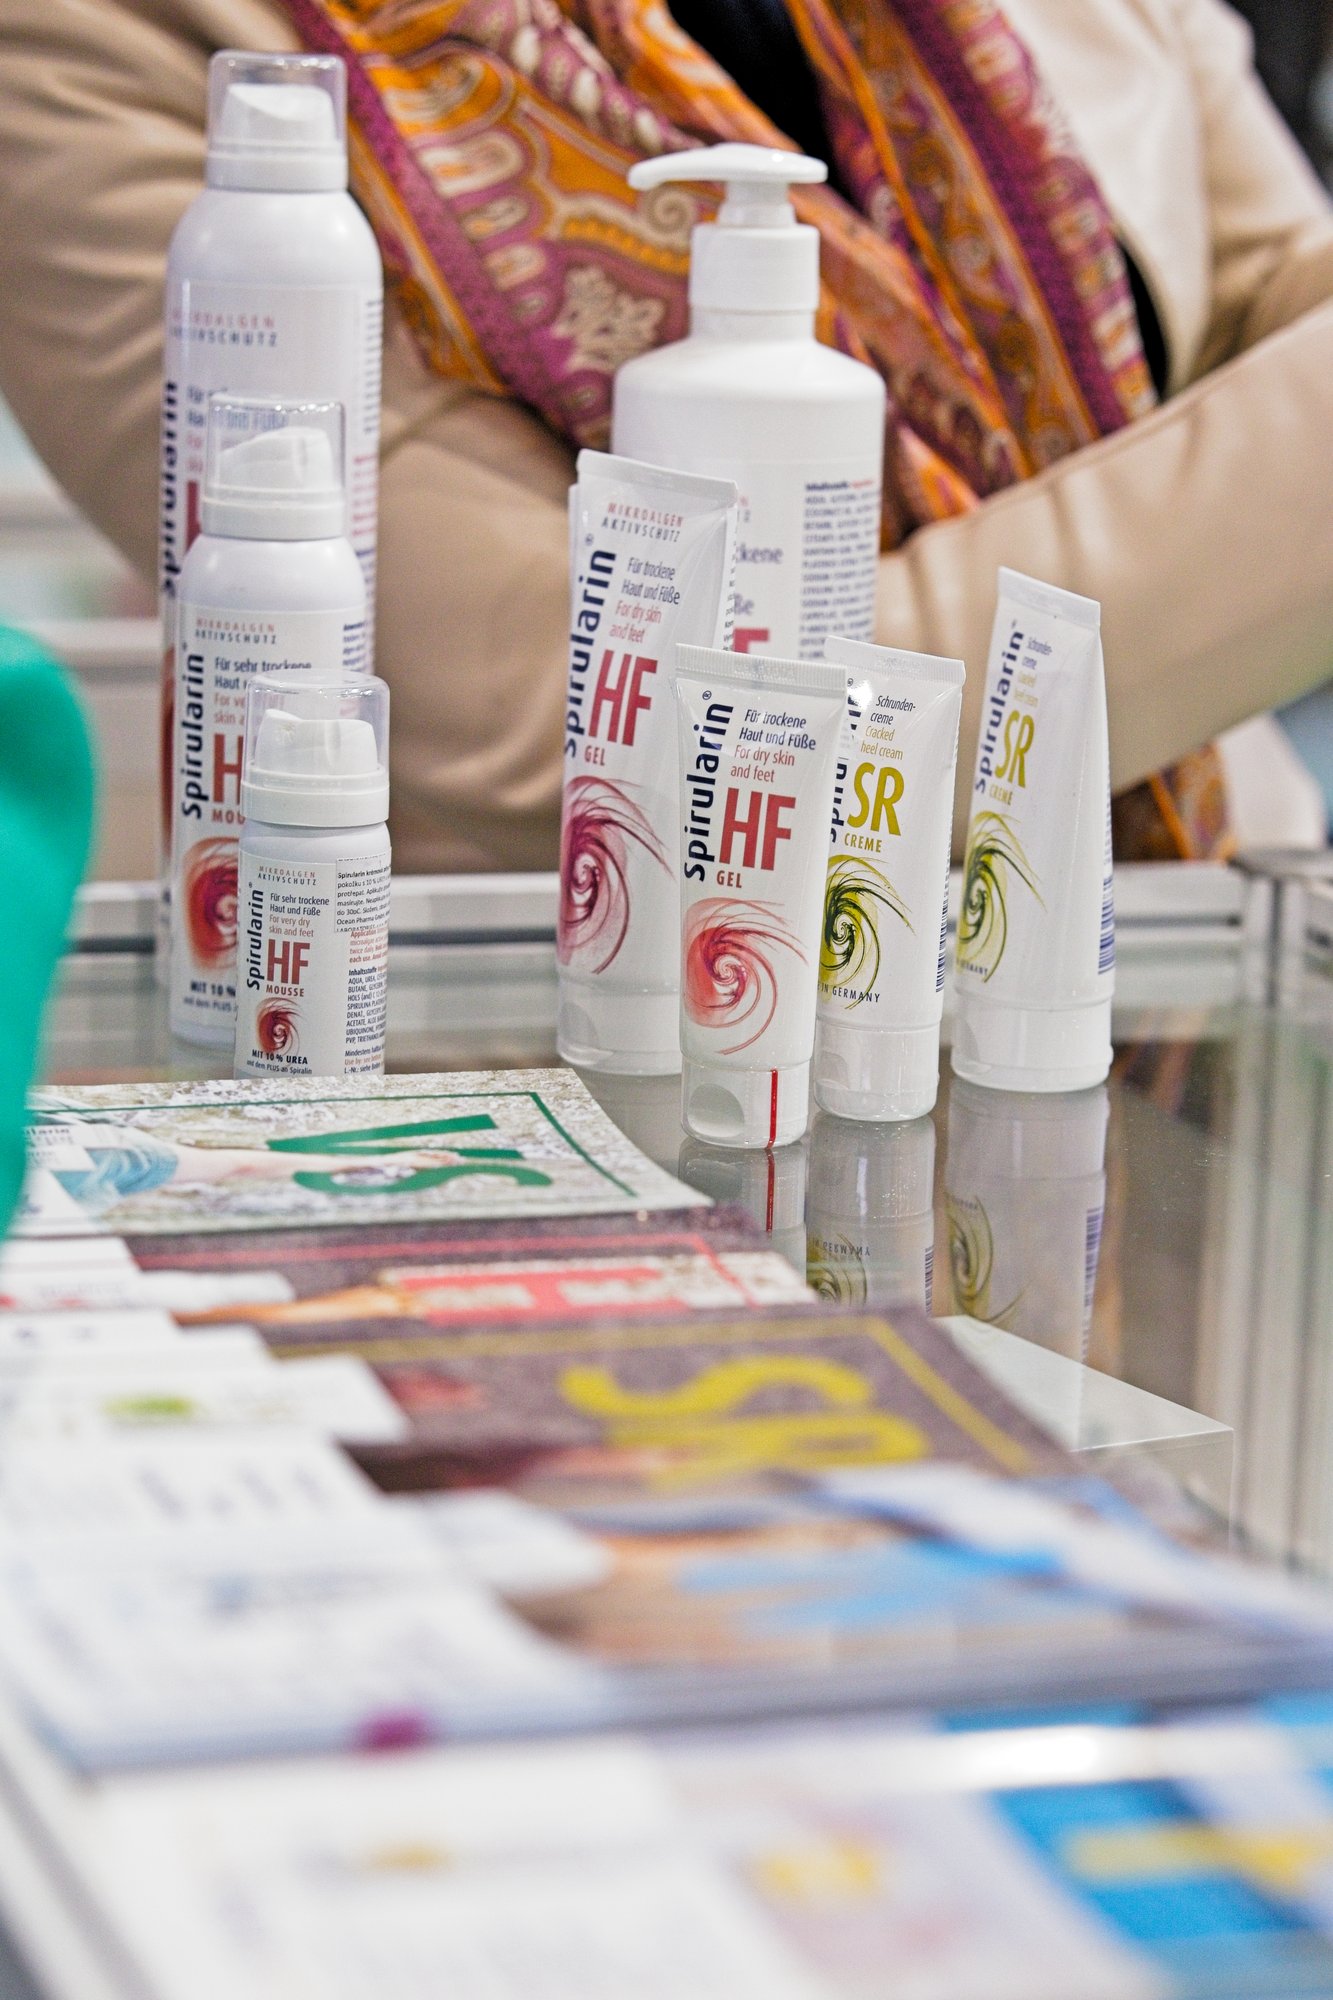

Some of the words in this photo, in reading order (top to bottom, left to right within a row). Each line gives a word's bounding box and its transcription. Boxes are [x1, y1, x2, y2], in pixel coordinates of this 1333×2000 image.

[608, 502, 684, 527] MIKROALGEN
[601, 517, 680, 542] AKTIVSCHUTZ
[627, 557, 643, 574] Für
[643, 561, 676, 581] trockene
[621, 579, 643, 598] Haut
[643, 583, 659, 600] und
[659, 585, 680, 605] Füße
[615, 600, 632, 616] For
[632, 602, 645, 623] dry
[195, 630, 277, 644] AKTIVSCHUTZ
[609, 623, 628, 640] and
[628, 623, 646, 643] feet
[215, 656, 230, 671] Für
[234, 657, 258, 672] sehr
[215, 676, 240, 689] Haut
[214, 692, 230, 706] For
[588, 649, 658, 747] HF
[876, 695, 916, 712] Schrunden-
[214, 710, 236, 724] skin
[744, 709, 760, 723] Für
[762, 710, 807, 729] trockene
[870, 712, 894, 726] creme
[738, 726, 763, 743] Haut
[765, 731, 785, 746] und
[787, 733, 817, 751] Füße
[865, 725, 895, 742] Cracked
[584, 745, 605, 766] GEL
[734, 745, 751, 760] For
[753, 747, 770, 767] dry
[773, 749, 795, 767] skin
[861, 741, 878, 755] heel
[879, 746, 904, 761] cream
[994, 710, 1035, 788] SR
[730, 764, 751, 780] and
[753, 766, 775, 783] feet
[846, 762, 904, 837] SR
[989, 783, 1013, 806] CREME
[719, 787, 797, 872] HF
[844, 832, 882, 853] CREME
[258, 873, 317, 886] AKTIVSCHUTZ
[259, 866, 316, 878] MIKROALGEN
[716, 870, 742, 889] GEL
[270, 893, 280, 901] Für
[281, 894, 297, 904] sehr
[298, 896, 330, 906] trockene
[269, 904, 285, 913] Haut
[287, 906, 301, 915] und
[303, 907, 321, 916] Füße
[269, 914, 279, 923] For
[281, 917, 297, 927] very
[298, 917, 310, 928] dry
[269, 925, 282, 934] skin
[284, 927, 297, 937] and
[299, 928, 314, 938] feet
[267, 938, 310, 985] HF
[191, 980, 207, 994] MIT
[211, 983, 224, 996] 10
[266, 984, 304, 997] MOUSSE
[821, 982, 829, 993] IN
[832, 985, 880, 1003] GERMANY
[252, 1049, 263, 1059] MIT
[266, 1052, 274, 1061] 10
[276, 1053, 283, 1062] %
[286, 1055, 308, 1065] UREA
[255, 1060, 265, 1070] dem
[266, 1063, 280, 1072] PLUS
[280, 1065, 288, 1073] an
[290, 1066, 312, 1075] Spiralin
